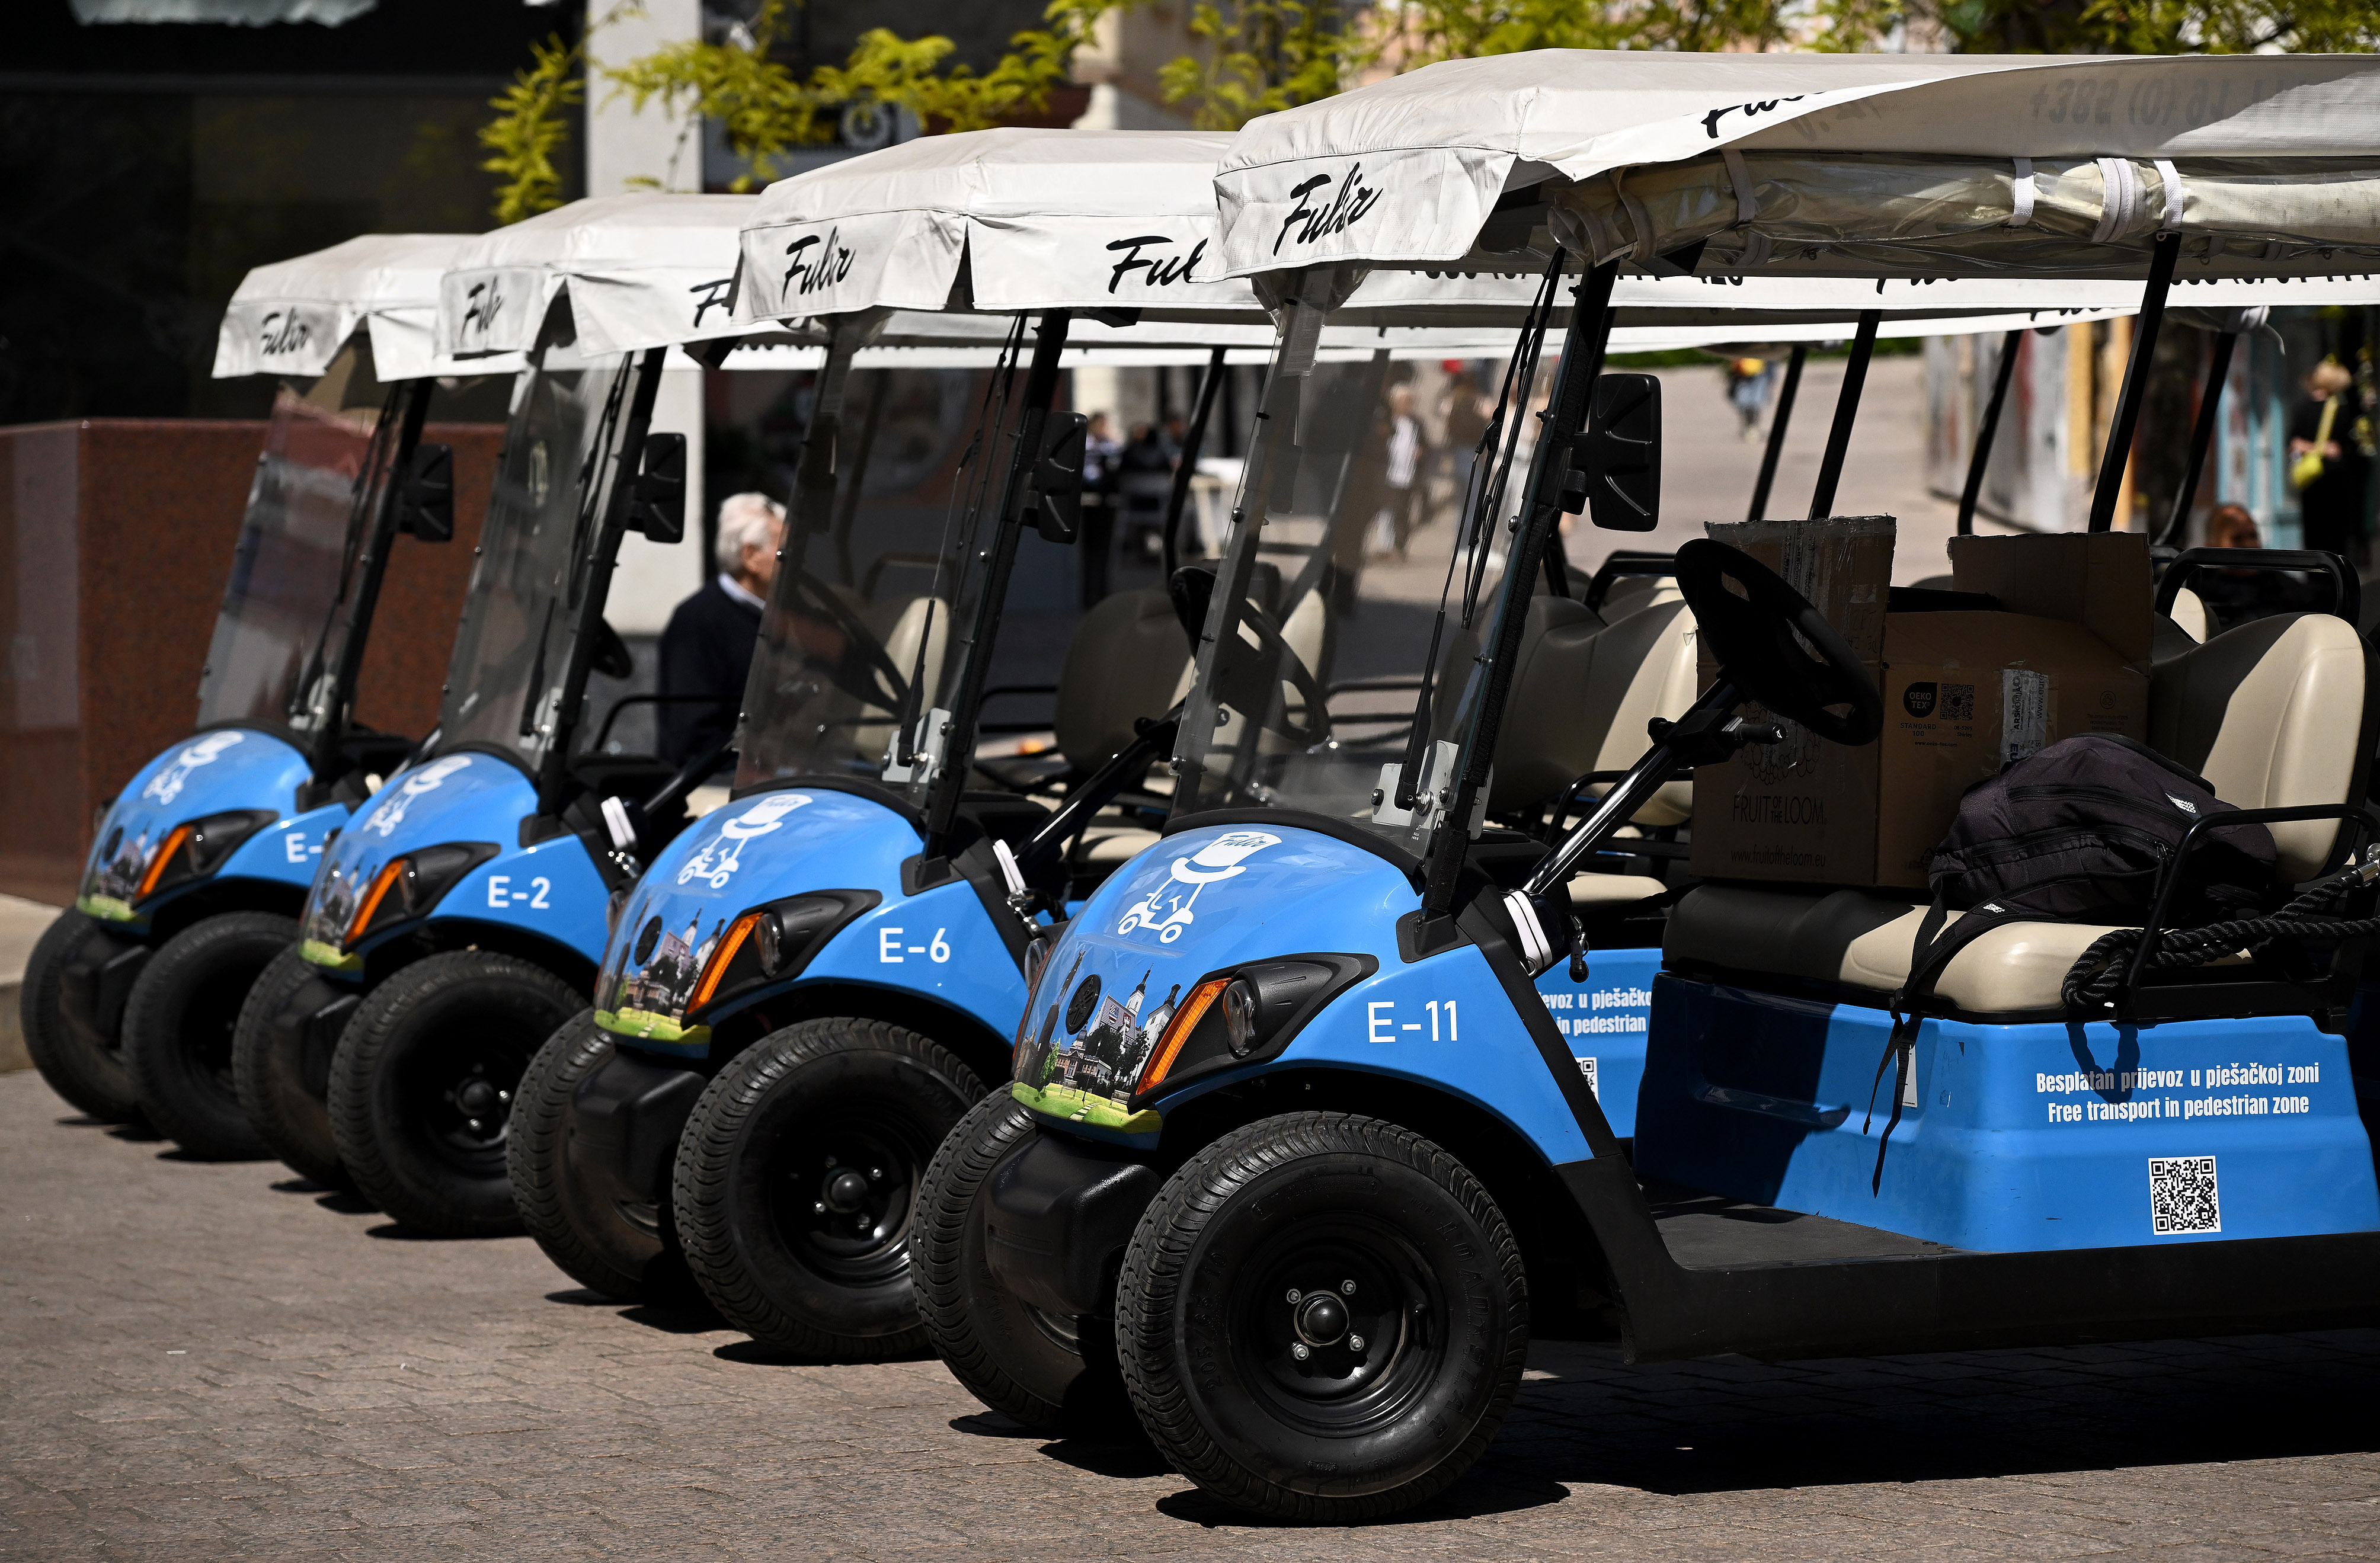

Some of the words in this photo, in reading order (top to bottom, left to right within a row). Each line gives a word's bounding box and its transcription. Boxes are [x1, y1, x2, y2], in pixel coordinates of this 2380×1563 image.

[1274, 161, 1383, 257] Fulir
[782, 226, 857, 303] Fulir
[1106, 236, 1209, 294] Ful
[1909, 692, 1932, 700] OEKO
[1733, 795, 1771, 824] FRUIT
[1772, 796, 1783, 809] OF
[1784, 796, 1824, 825] LOOM
[1771, 810, 1783, 824] THE
[286, 832, 330, 863] E-
[1730, 844, 1826, 867] www.fruitoftheloom.eu
[488, 876, 551, 909] E-2
[879, 928, 951, 963] E-6
[1538, 991, 1573, 1009] evoz
[1579, 994, 1588, 1008] u
[1368, 1000, 1458, 1043] E-11
[1556, 1016, 1570, 1034] in
[1573, 1014, 1646, 1036] pedestrian
[2036, 1070, 2116, 1095] Besplatan
[2121, 1068, 2184, 1092] prijevoz
[2190, 1069, 2200, 1087] u
[2206, 1062, 2283, 1090] pješačkoj
[2287, 1062, 2320, 1084] zoni
[2048, 1101, 2082, 1123] Free
[2087, 1096, 2161, 1122] transport
[2165, 1095, 2180, 1117] in
[2184, 1094, 2269, 1120] pedestrian
[2273, 1096, 2310, 1114] zone
